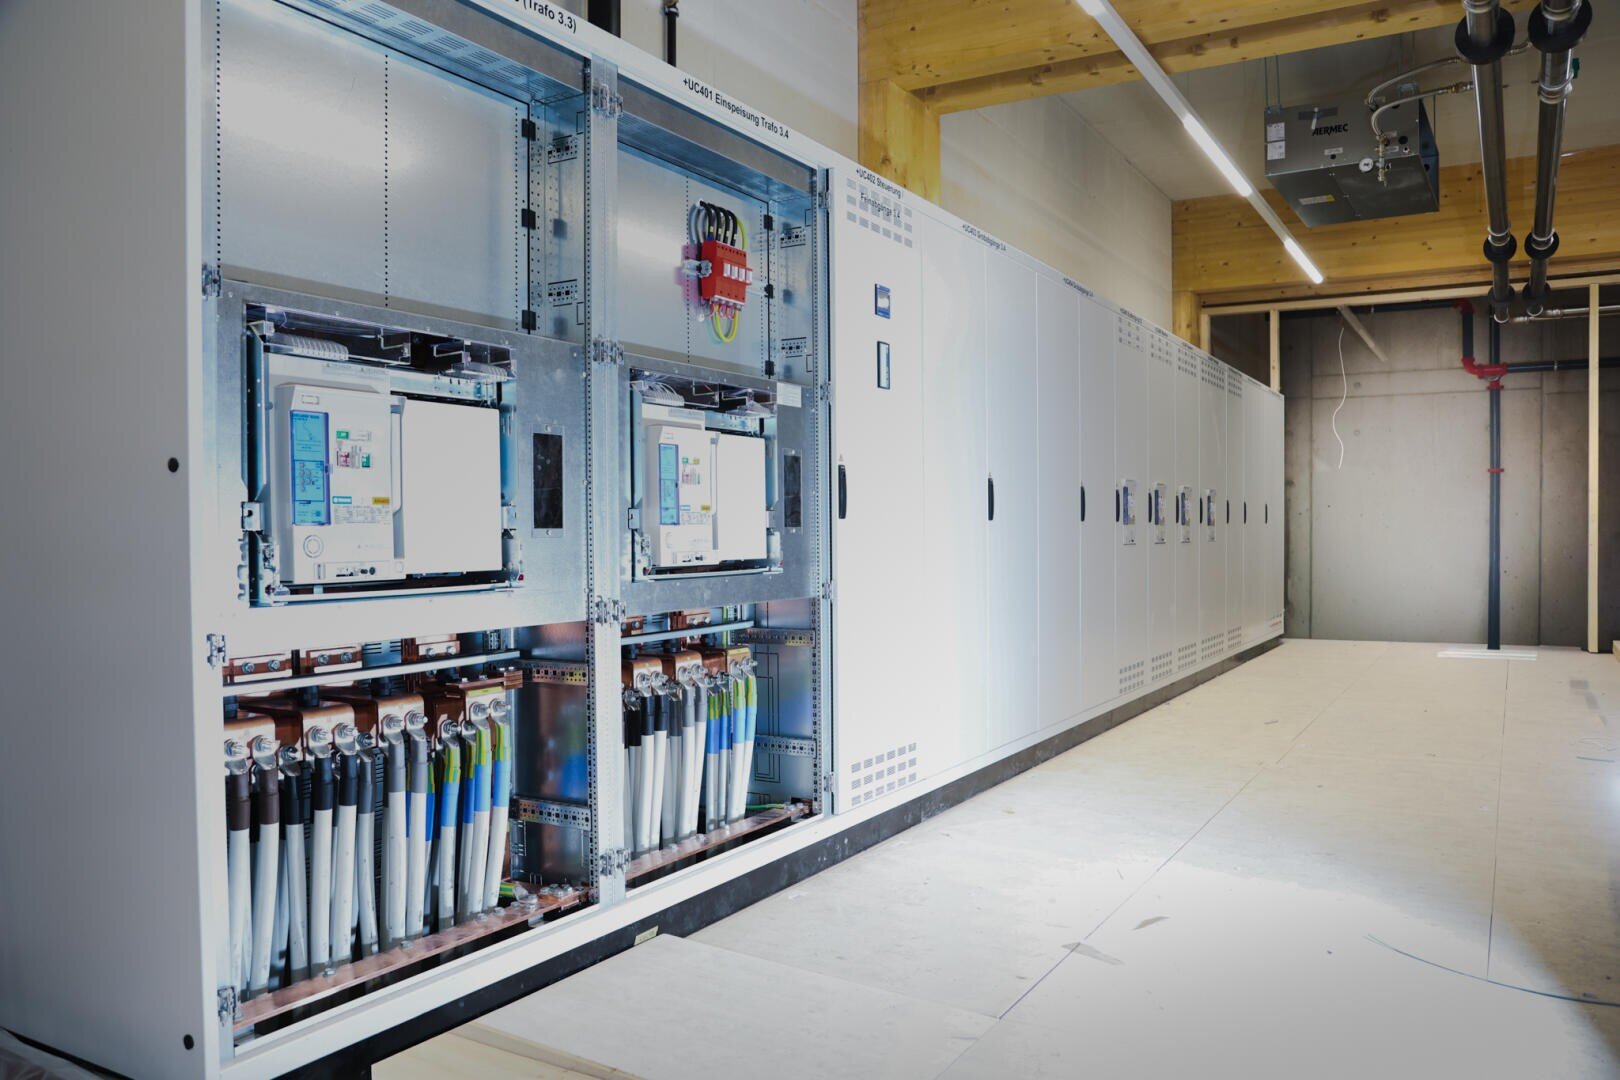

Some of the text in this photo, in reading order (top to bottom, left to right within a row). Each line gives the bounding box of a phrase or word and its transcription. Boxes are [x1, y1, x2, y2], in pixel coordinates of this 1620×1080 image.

[557, 11, 577, 34] 3.3)
[683, 78, 789, 139] +UC401 Einspeisung Trafo 3.4
[1312, 123, 1349, 136] AERMEC
